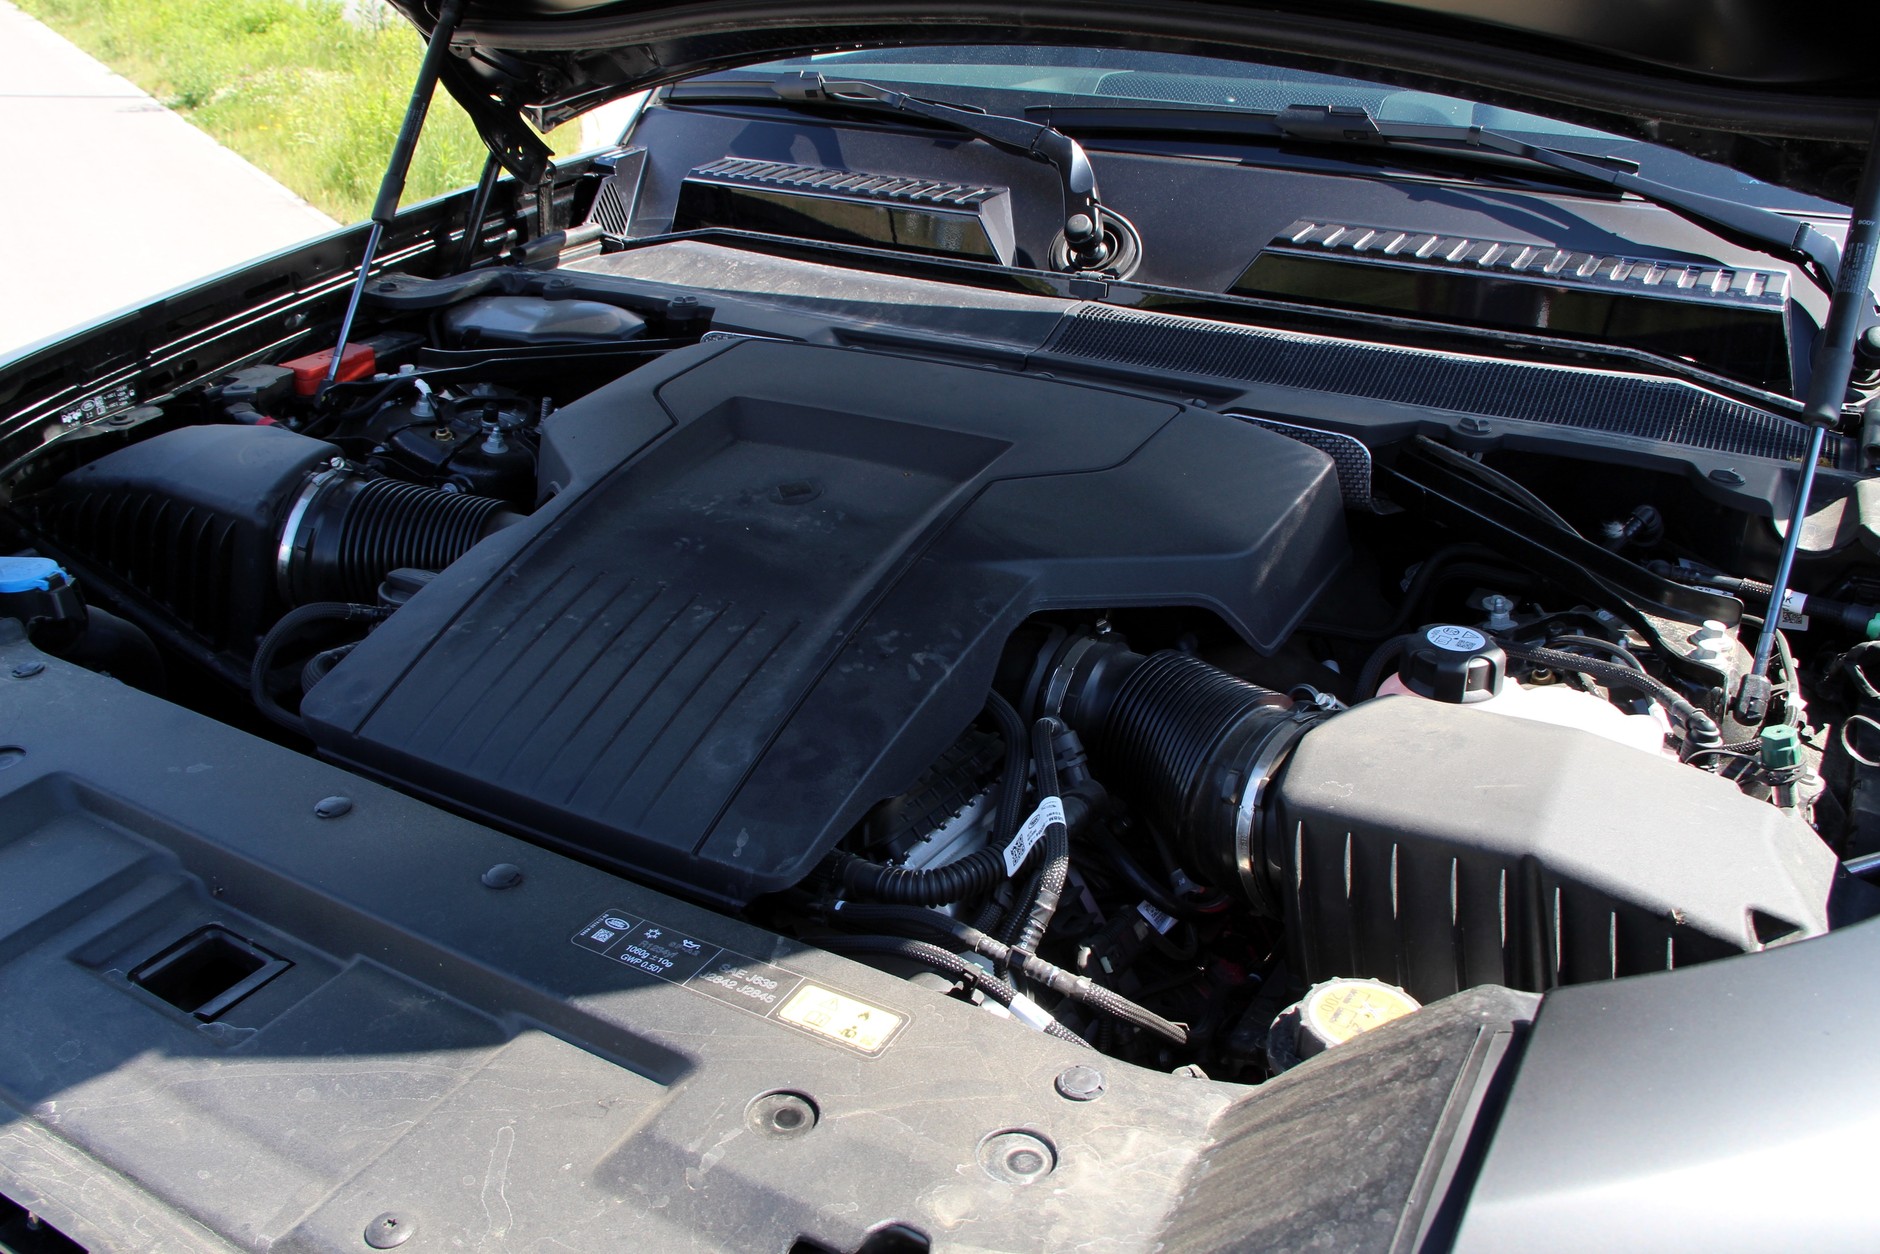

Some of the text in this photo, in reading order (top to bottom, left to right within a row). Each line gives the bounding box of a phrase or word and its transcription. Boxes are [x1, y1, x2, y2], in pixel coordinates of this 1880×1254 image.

[620, 953, 664, 974] GWP 0.501
[719, 963, 778, 990] SAE J639
[699, 971, 777, 1003] J2842 J2845
